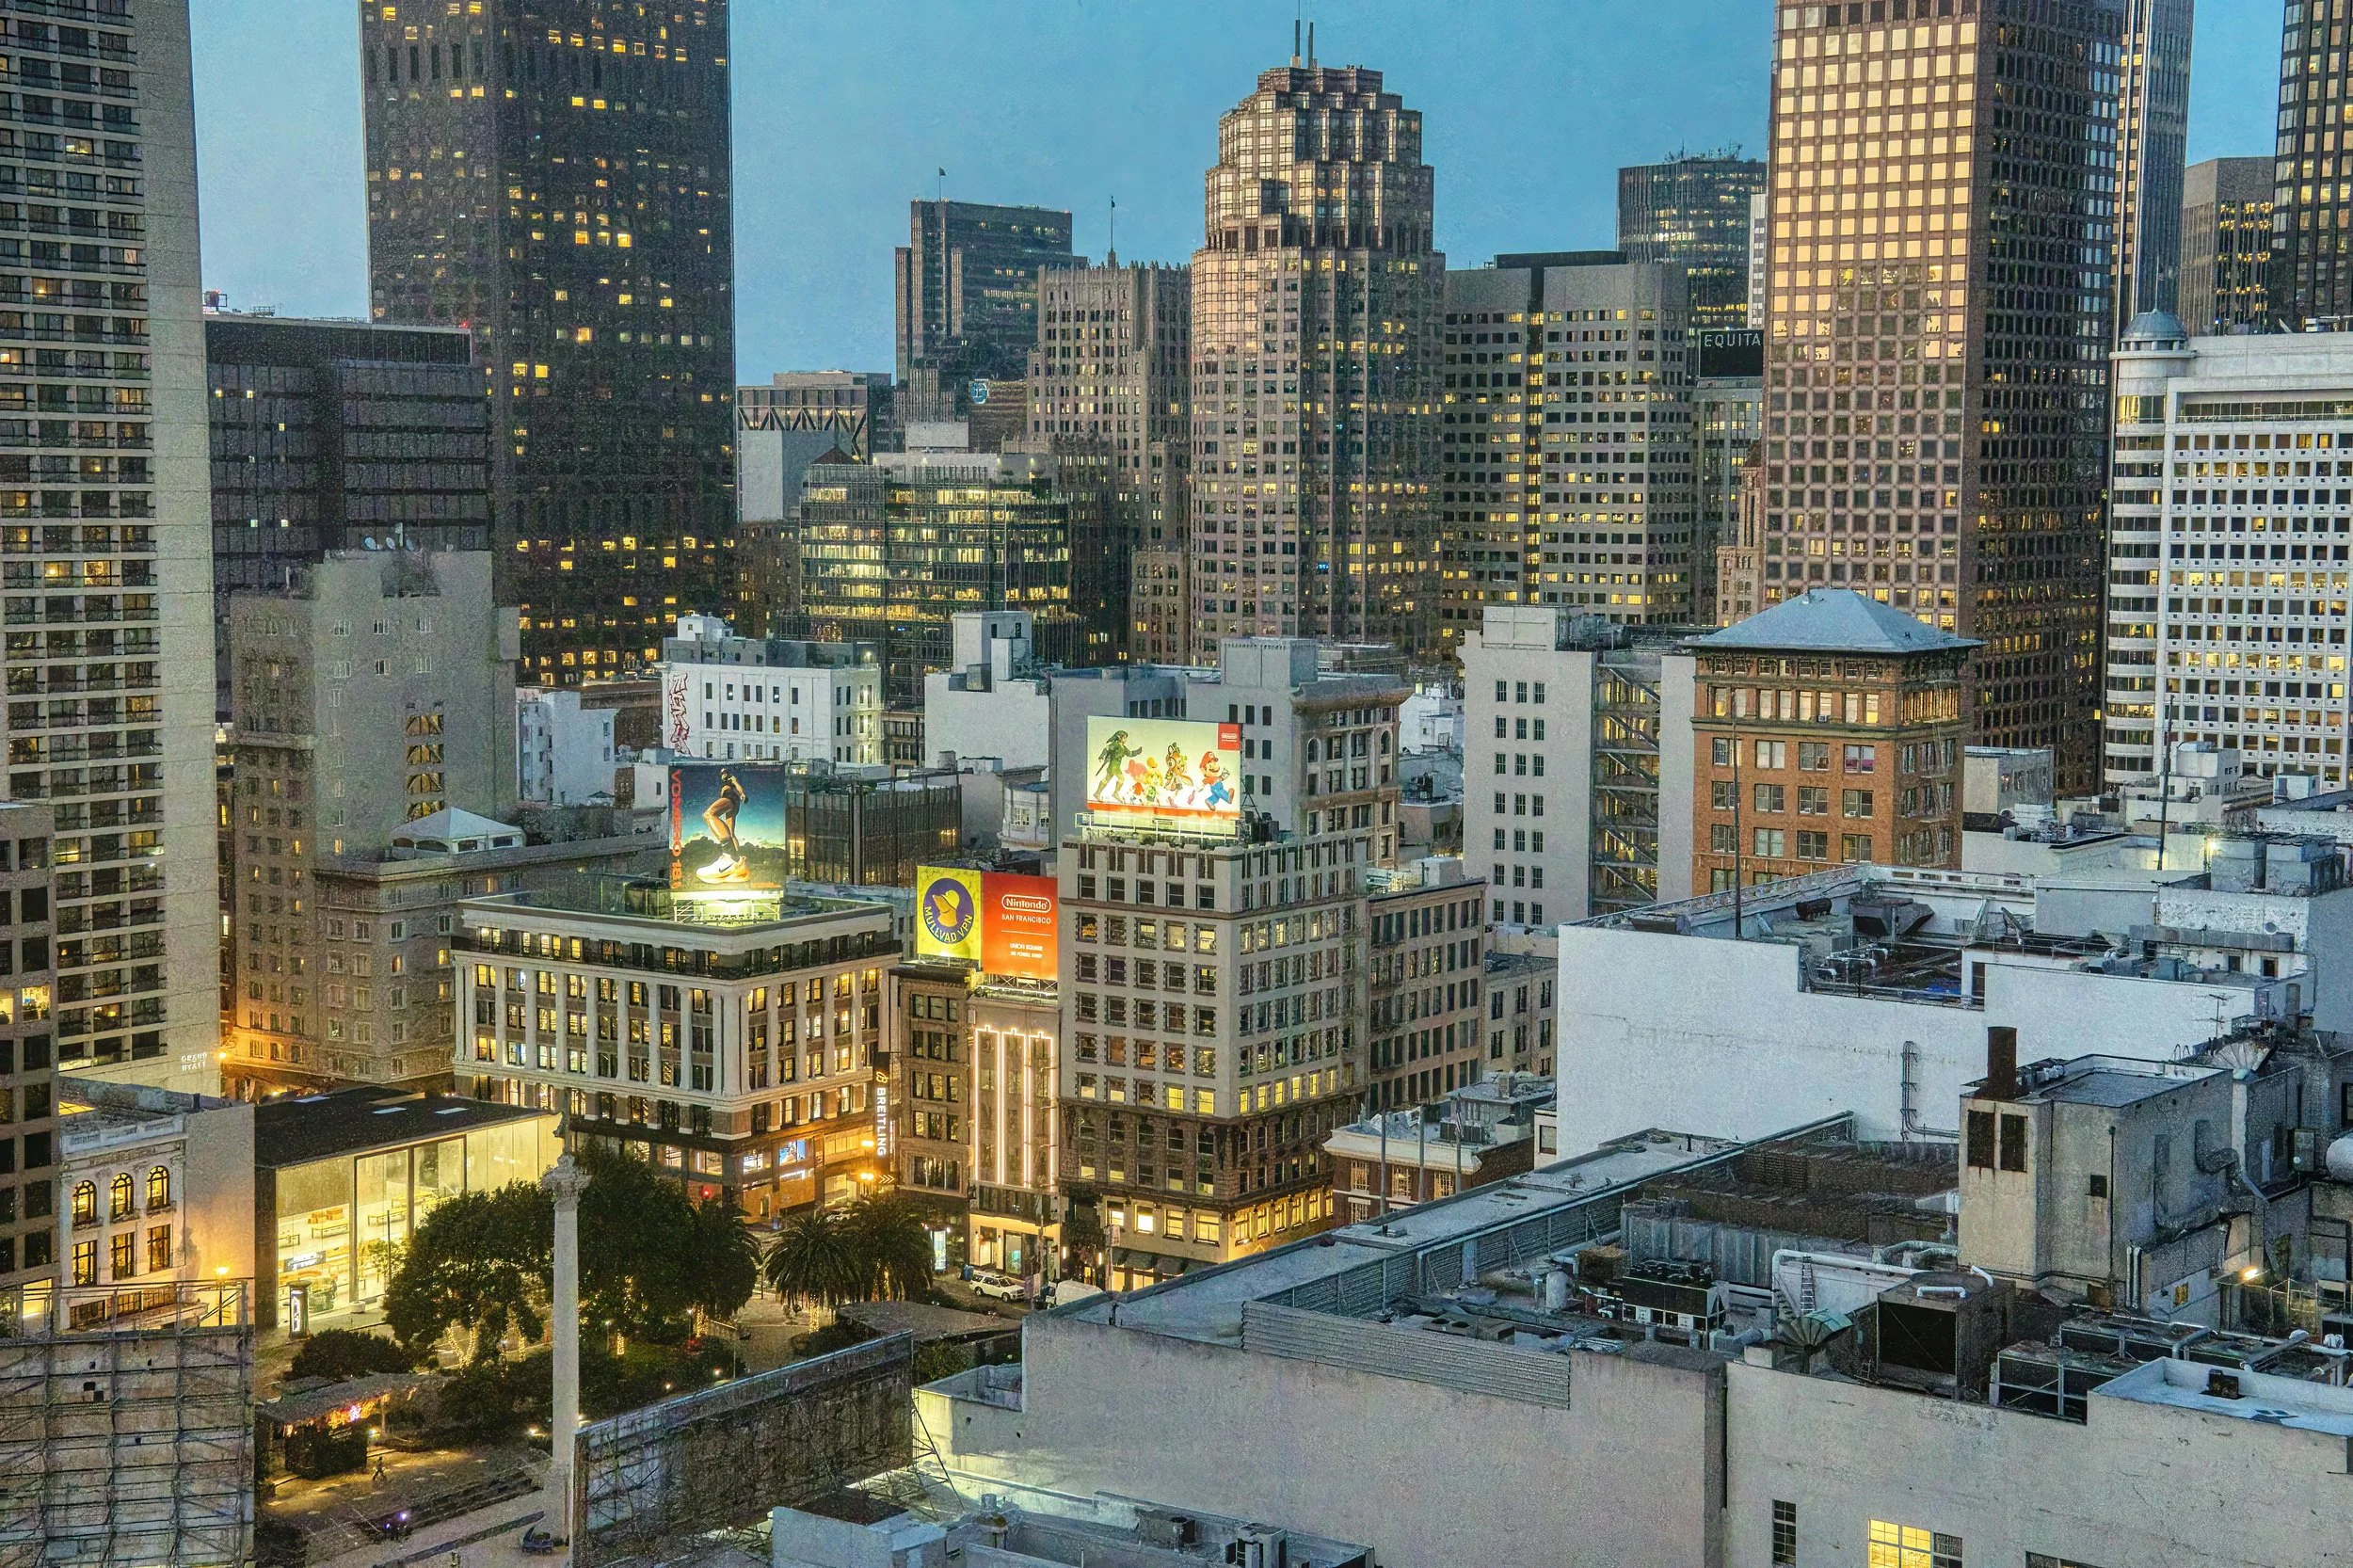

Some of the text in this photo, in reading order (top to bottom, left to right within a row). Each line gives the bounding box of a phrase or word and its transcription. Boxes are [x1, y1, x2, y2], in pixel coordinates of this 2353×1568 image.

[1705, 332, 1761, 348] EQUITA
[1005, 897, 1048, 911] Nintendo
[924, 906, 973, 942] MULLVAD VPN
[1001, 913, 1051, 924] SAN FRANCISCO
[876, 1087, 887, 1157] BREITLING
